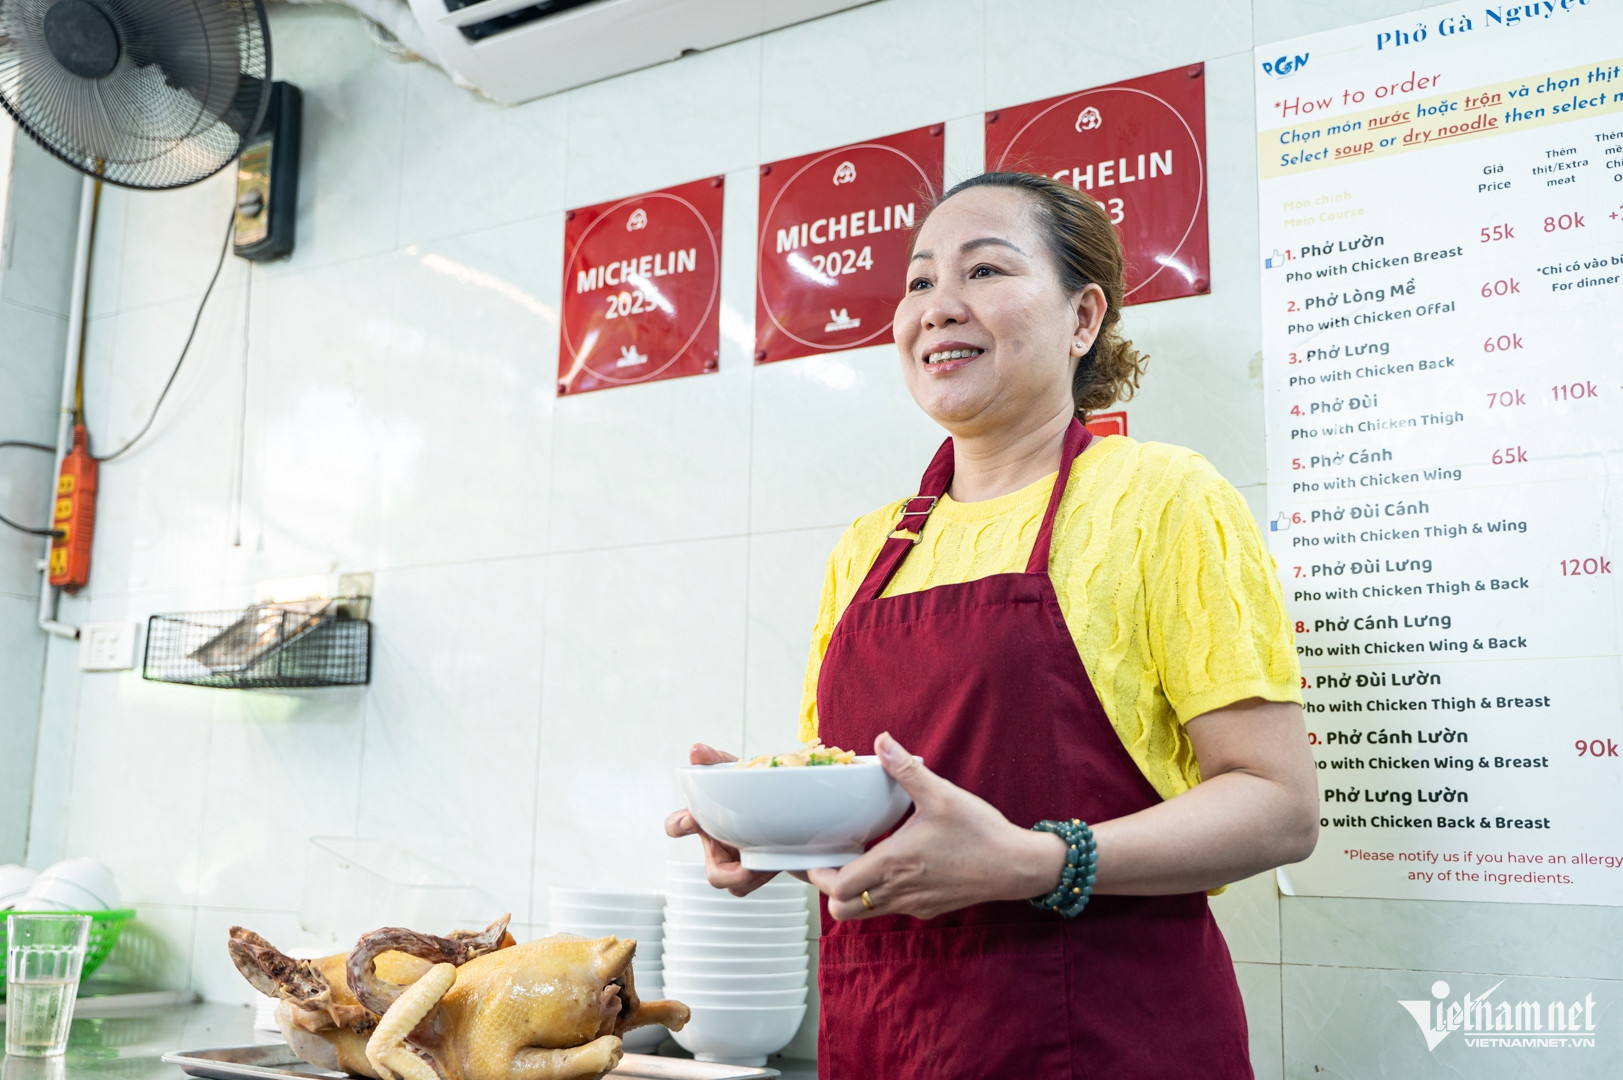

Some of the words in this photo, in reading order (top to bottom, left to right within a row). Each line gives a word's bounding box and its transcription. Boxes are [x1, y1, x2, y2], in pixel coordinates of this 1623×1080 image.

[1376, 22, 1428, 52] Phở
[1437, 14, 1473, 37] Gà
[1342, 89, 1365, 106] to
[1374, 70, 1441, 99] order
[1279, 128, 1321, 145] Chọn
[1326, 120, 1362, 137] món
[1367, 110, 1412, 131] nước
[1416, 99, 1459, 119] hoặc
[1463, 91, 1503, 112] trộn
[1507, 84, 1530, 99] và
[1535, 76, 1580, 94] chọn
[1586, 65, 1621, 84] thịt
[1280, 147, 1329, 167] Select
[1334, 141, 1375, 161] soup
[1378, 136, 1397, 148] or
[1402, 127, 1432, 147] dry
[1437, 113, 1499, 142] noodle
[1504, 106, 1546, 124] then
[1551, 92, 1607, 115] select
[1544, 147, 1577, 159] Thêm
[1482, 162, 1505, 176] Giá
[1477, 180, 1512, 194] Price
[1546, 174, 1576, 188] meat
[776, 203, 915, 253] MICHELIN
[1480, 222, 1515, 244] 55k
[1543, 211, 1586, 233] 80k
[1284, 249, 1297, 261] 1.
[1300, 240, 1335, 259] Phở
[1338, 234, 1385, 253] Lườn
[576, 248, 697, 294] MICHELIN
[812, 246, 873, 277] 2024
[1285, 271, 1313, 284] Pho
[1315, 264, 1348, 279] with
[1351, 255, 1410, 273] Chicken
[1413, 245, 1464, 263] Breast
[1565, 260, 1581, 273] có
[1583, 257, 1609, 270] vào
[1287, 300, 1301, 313] 2.
[1304, 291, 1339, 310] Phở
[1342, 288, 1386, 305] Lòng
[1390, 277, 1416, 298] Mề
[1480, 277, 1521, 298] 60k
[1551, 282, 1574, 293] For
[1576, 275, 1621, 289] dinner
[1287, 323, 1315, 335] Pho
[1317, 316, 1350, 331] with
[1353, 309, 1412, 326] Chicken
[1415, 300, 1456, 317] Offal
[1288, 352, 1303, 365] 3.
[1306, 344, 1341, 363] Phở
[1344, 341, 1390, 357] Lưng
[1483, 332, 1524, 353] 60k
[1289, 375, 1316, 388] Pho
[1319, 369, 1352, 383] with
[1355, 363, 1415, 379] Chicken
[1418, 356, 1455, 371] Back
[1486, 388, 1526, 409] 70k
[1551, 380, 1598, 402] 110k
[1289, 404, 1306, 417] 4.
[1310, 397, 1345, 415] Phở
[1347, 393, 1378, 411] Đùi
[1290, 427, 1318, 440] Pho
[1321, 423, 1354, 436] with
[1357, 418, 1417, 433] Chicken
[1420, 410, 1464, 426] Thigh
[1291, 457, 1306, 471] 5.
[1310, 451, 1345, 469] Phở
[1348, 448, 1393, 465] Cánh
[1491, 445, 1529, 466] 65k
[1292, 481, 1320, 494] Pho
[1323, 476, 1356, 491] with
[1359, 472, 1420, 487] Chicken
[1422, 467, 1462, 482] Wing
[1291, 511, 1307, 525] 6.
[1310, 505, 1346, 523] Phở
[1349, 503, 1380, 520] Đùi
[1384, 500, 1430, 517] Cánh
[1292, 535, 1320, 548] Pho
[1323, 532, 1357, 545] with
[1359, 528, 1420, 543] Chicken
[1423, 523, 1468, 539] Thigh
[1471, 522, 1483, 534] &
[1486, 519, 1528, 534] Wing
[1292, 565, 1307, 579] 7.
[1311, 560, 1346, 578] Phở
[1349, 558, 1381, 575] Đùi
[1385, 558, 1433, 574] Lưng
[1559, 555, 1612, 577] 120k
[1293, 590, 1322, 603] Pho
[1324, 587, 1359, 601] with
[1361, 584, 1423, 598] Chicken
[1425, 580, 1471, 596] Thigh
[1474, 579, 1487, 592] &
[1490, 576, 1530, 591] Back
[1294, 620, 1311, 634] 8.
[1314, 615, 1350, 633] Phở
[1353, 614, 1399, 631] Cánh
[1403, 614, 1452, 630] Lưng
[1326, 642, 1361, 657] with
[1363, 640, 1425, 655] Chicken
[1428, 638, 1469, 654] Wing
[1472, 638, 1484, 650] &
[1487, 635, 1528, 650] Back
[1315, 671, 1352, 689] Phở
[1354, 671, 1387, 688] Đùi
[1391, 669, 1442, 687] Lườn
[1328, 699, 1363, 713] with
[1365, 698, 1428, 712] Chicken
[1430, 696, 1477, 713] Thigh
[1479, 696, 1492, 709] &
[1495, 695, 1551, 709] Breast
[1326, 728, 1363, 746] Phở
[1366, 728, 1413, 745] Cánh
[1417, 726, 1469, 744] Lườn
[1574, 737, 1620, 758] 90k
[1330, 756, 1365, 770] with
[1367, 755, 1431, 770] Chicken
[1433, 755, 1475, 772] Wing
[1477, 756, 1491, 769] &
[1493, 756, 1549, 769] Breast
[1324, 786, 1361, 803] Phở
[1364, 788, 1413, 807] Lưng
[1417, 786, 1469, 804] Lườn
[1332, 814, 1367, 828] with
[1370, 814, 1433, 829] Chicken
[1436, 815, 1476, 829] Back
[1479, 816, 1492, 829] &
[1494, 816, 1551, 830] Breast
[1398, 850, 1440, 865] notify
[1442, 853, 1460, 863] us
[1463, 850, 1473, 863] if
[1475, 853, 1503, 866] you
[1507, 851, 1544, 864] have
[1547, 855, 1567, 865] an
[1571, 852, 1623, 869] allergy
[1407, 871, 1434, 884] any
[1437, 869, 1452, 881] of
[1454, 869, 1480, 882] the
[1483, 870, 1574, 886] ingredients.
